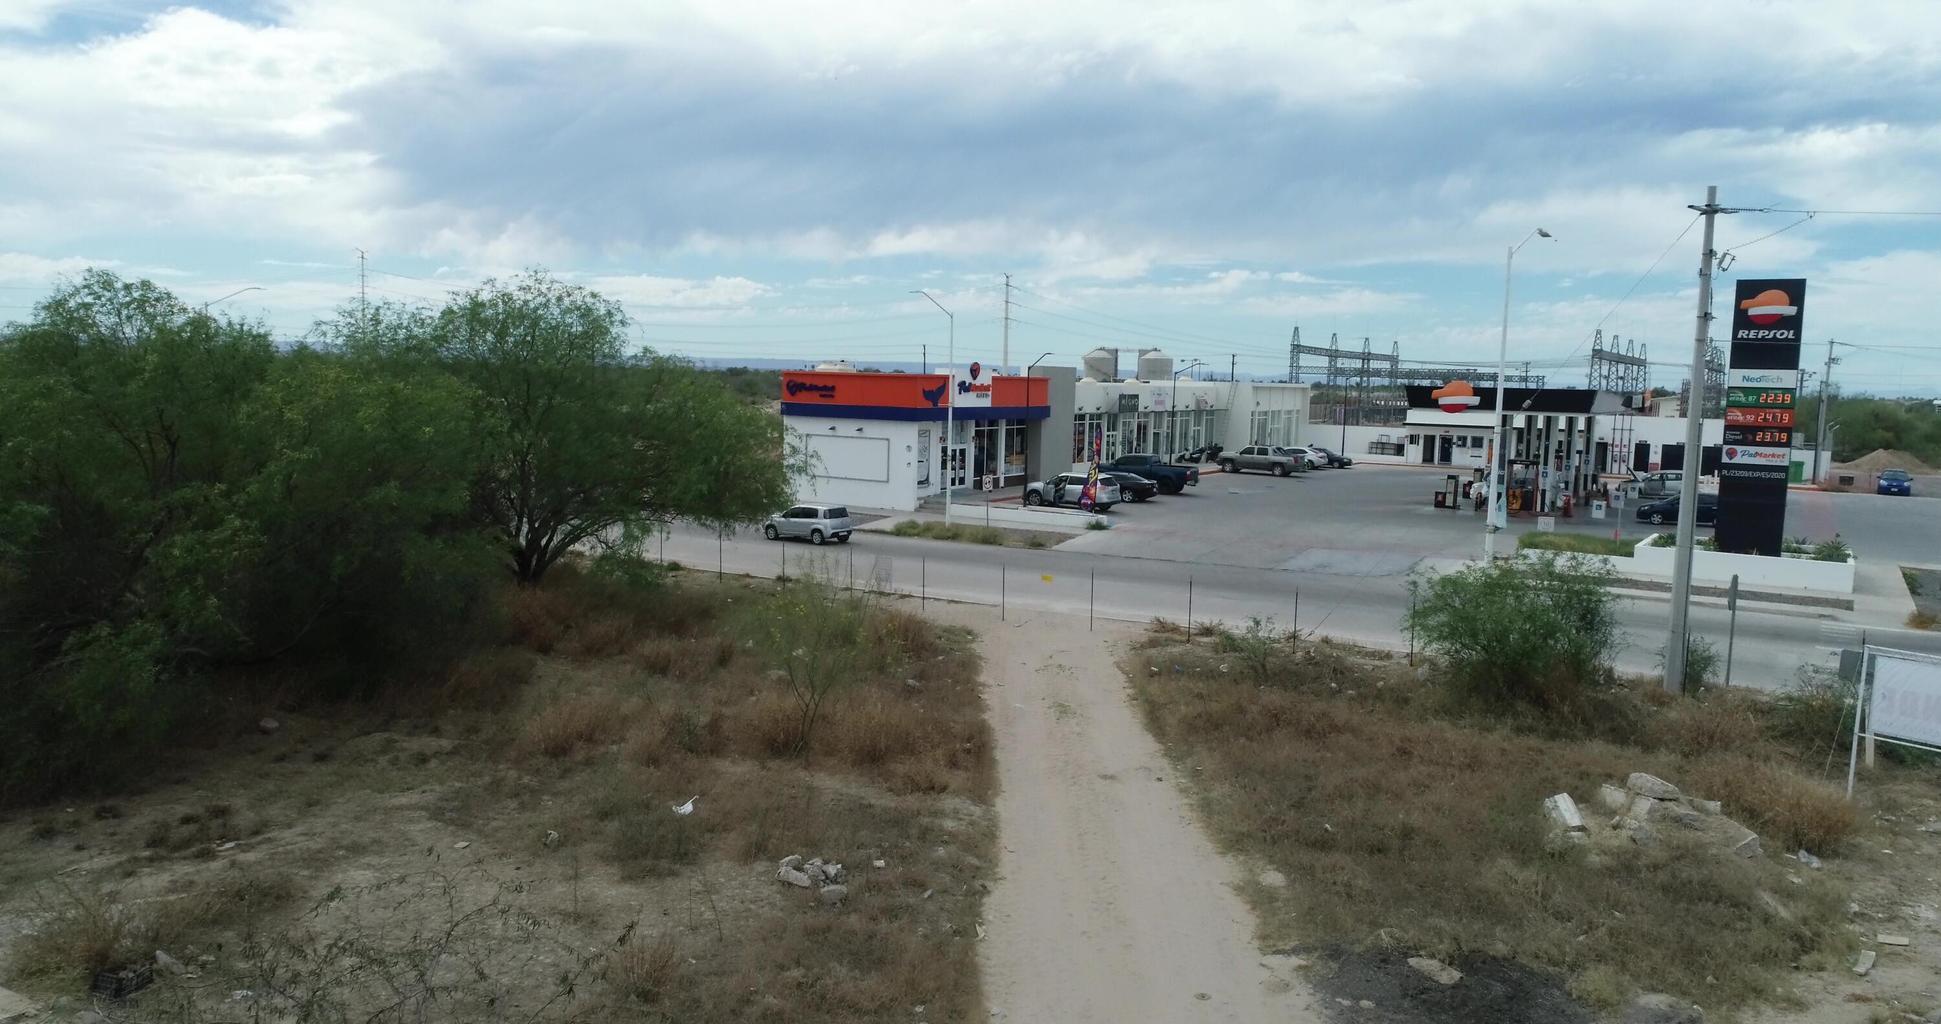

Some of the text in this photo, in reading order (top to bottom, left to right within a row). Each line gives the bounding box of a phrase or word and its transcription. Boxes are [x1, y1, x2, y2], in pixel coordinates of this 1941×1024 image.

[1737, 329, 1796, 339] REPSOL
[1742, 375, 1783, 383] NeoTech
[1740, 450, 1786, 459] PalMarket
